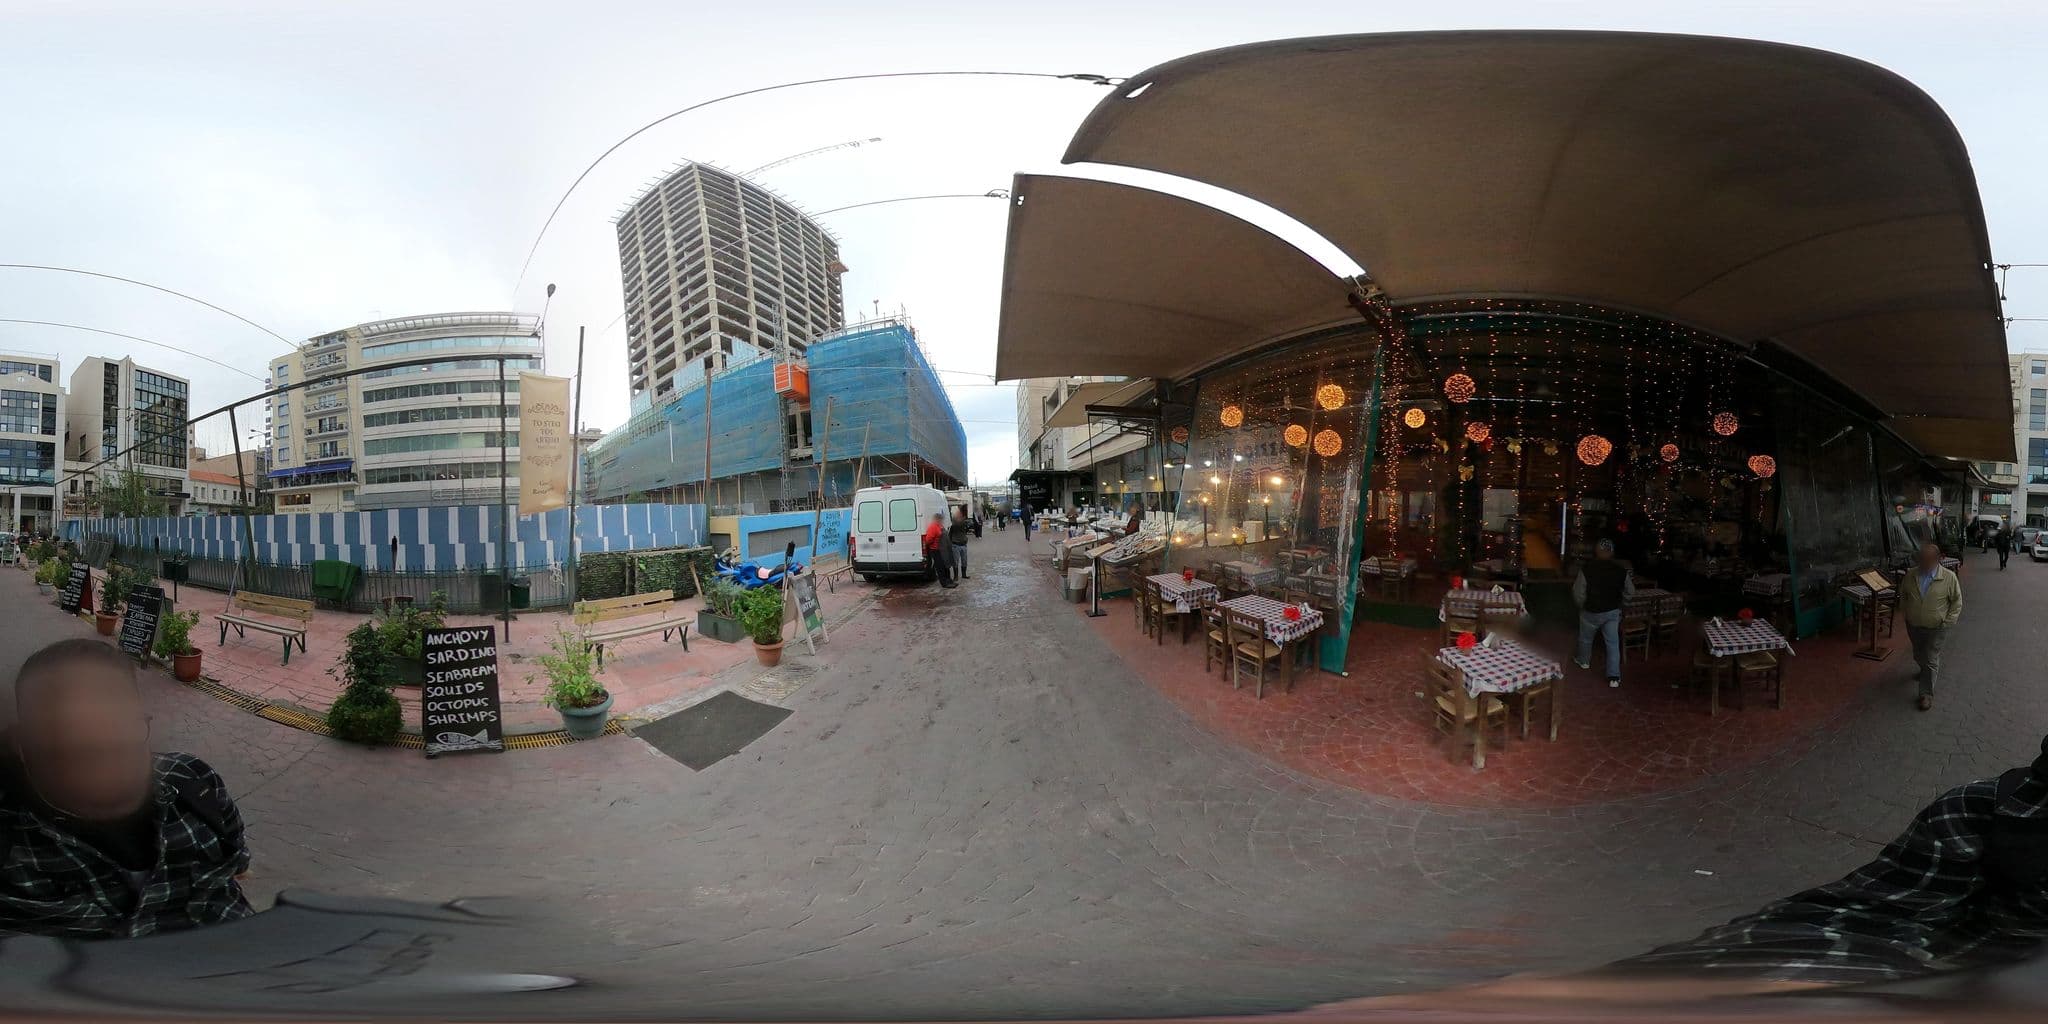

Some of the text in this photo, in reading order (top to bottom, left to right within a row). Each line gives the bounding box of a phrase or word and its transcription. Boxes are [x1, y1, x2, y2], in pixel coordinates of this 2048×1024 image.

[427, 630, 488, 645] ANCHOVY
[426, 664, 497, 683] SEABREAM
[426, 682, 485, 698] SQUIDS
[427, 698, 489, 711] OCTOPUS
[428, 711, 498, 725] SHRIMPS
